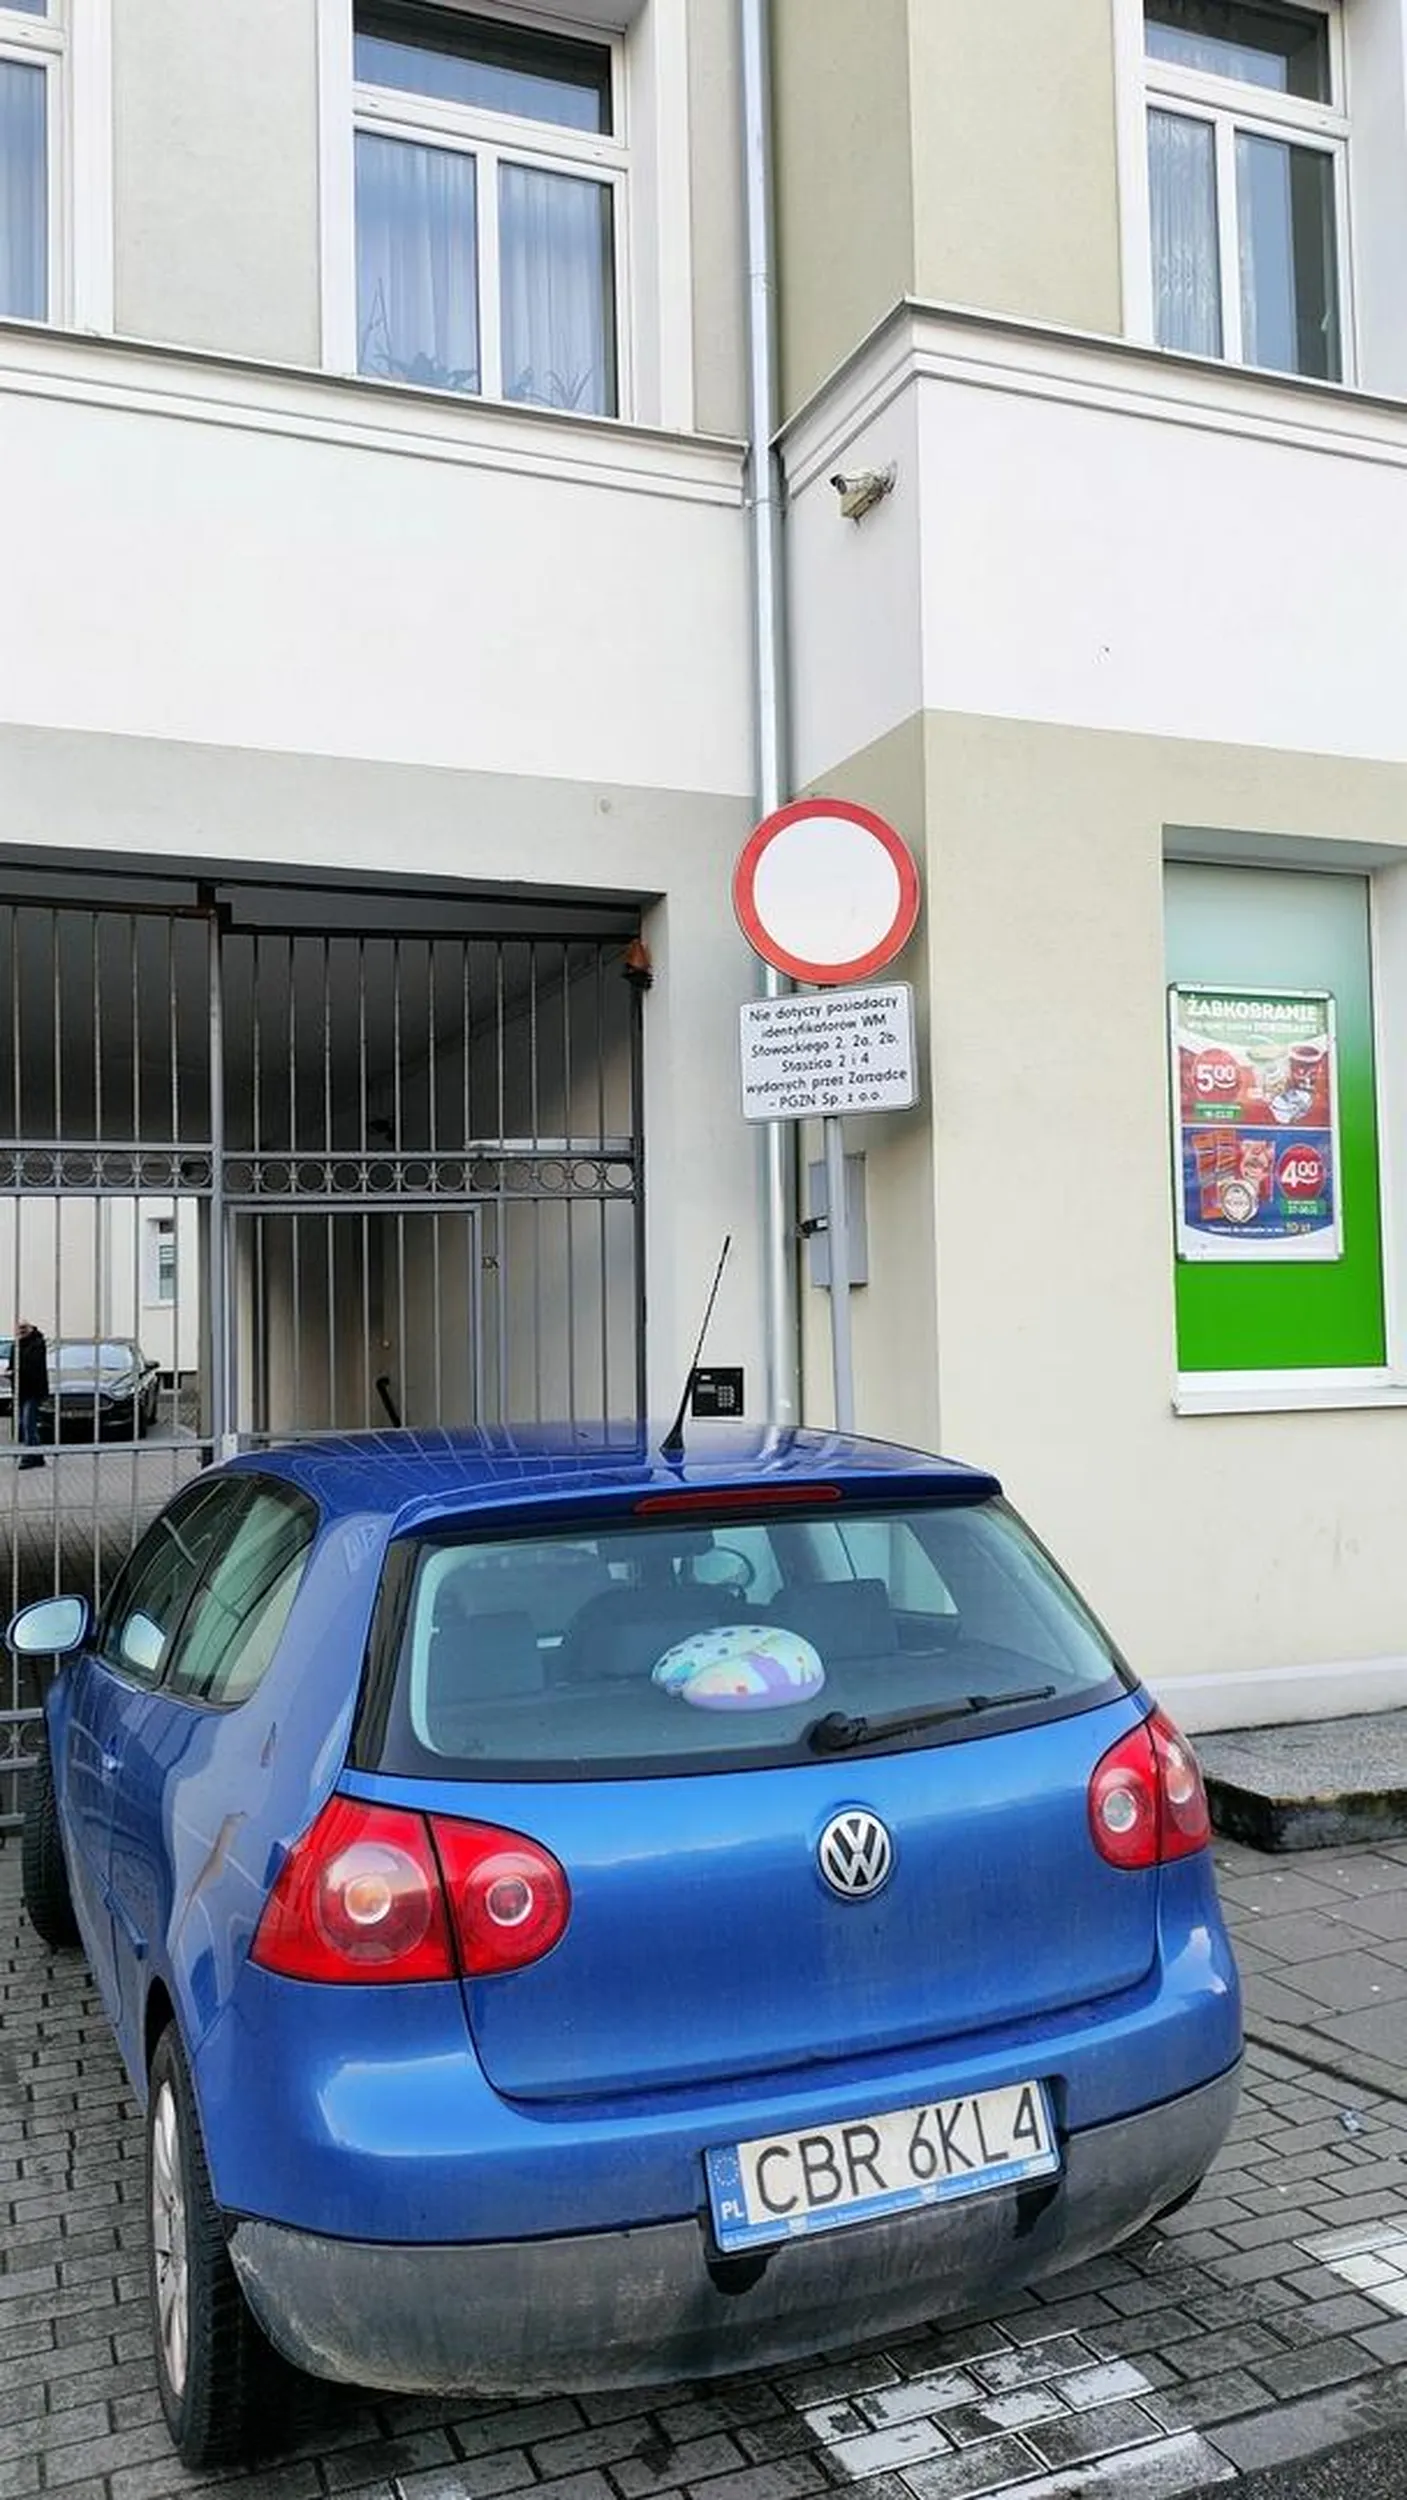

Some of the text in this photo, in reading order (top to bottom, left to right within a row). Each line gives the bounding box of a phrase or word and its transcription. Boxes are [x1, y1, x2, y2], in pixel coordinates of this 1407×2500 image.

[750, 998, 898, 1021] Nie dotyczy posiadaczy
[1186, 993, 1318, 1022] ŻABKOBRANIE
[861, 1014, 887, 1028] WM
[781, 1059, 832, 1073] Staszica
[839, 1055, 846, 1068] 2
[861, 1052, 870, 1064] 4
[746, 1078, 807, 1095] wydanych
[812, 1076, 844, 1090] przez
[779, 1093, 816, 1108] PGZN
[822, 1092, 843, 1106] Sp.
[756, 2124, 888, 2214] CBR
[908, 2086, 1042, 2180] 6KL4
[721, 2201, 744, 2220] PL
